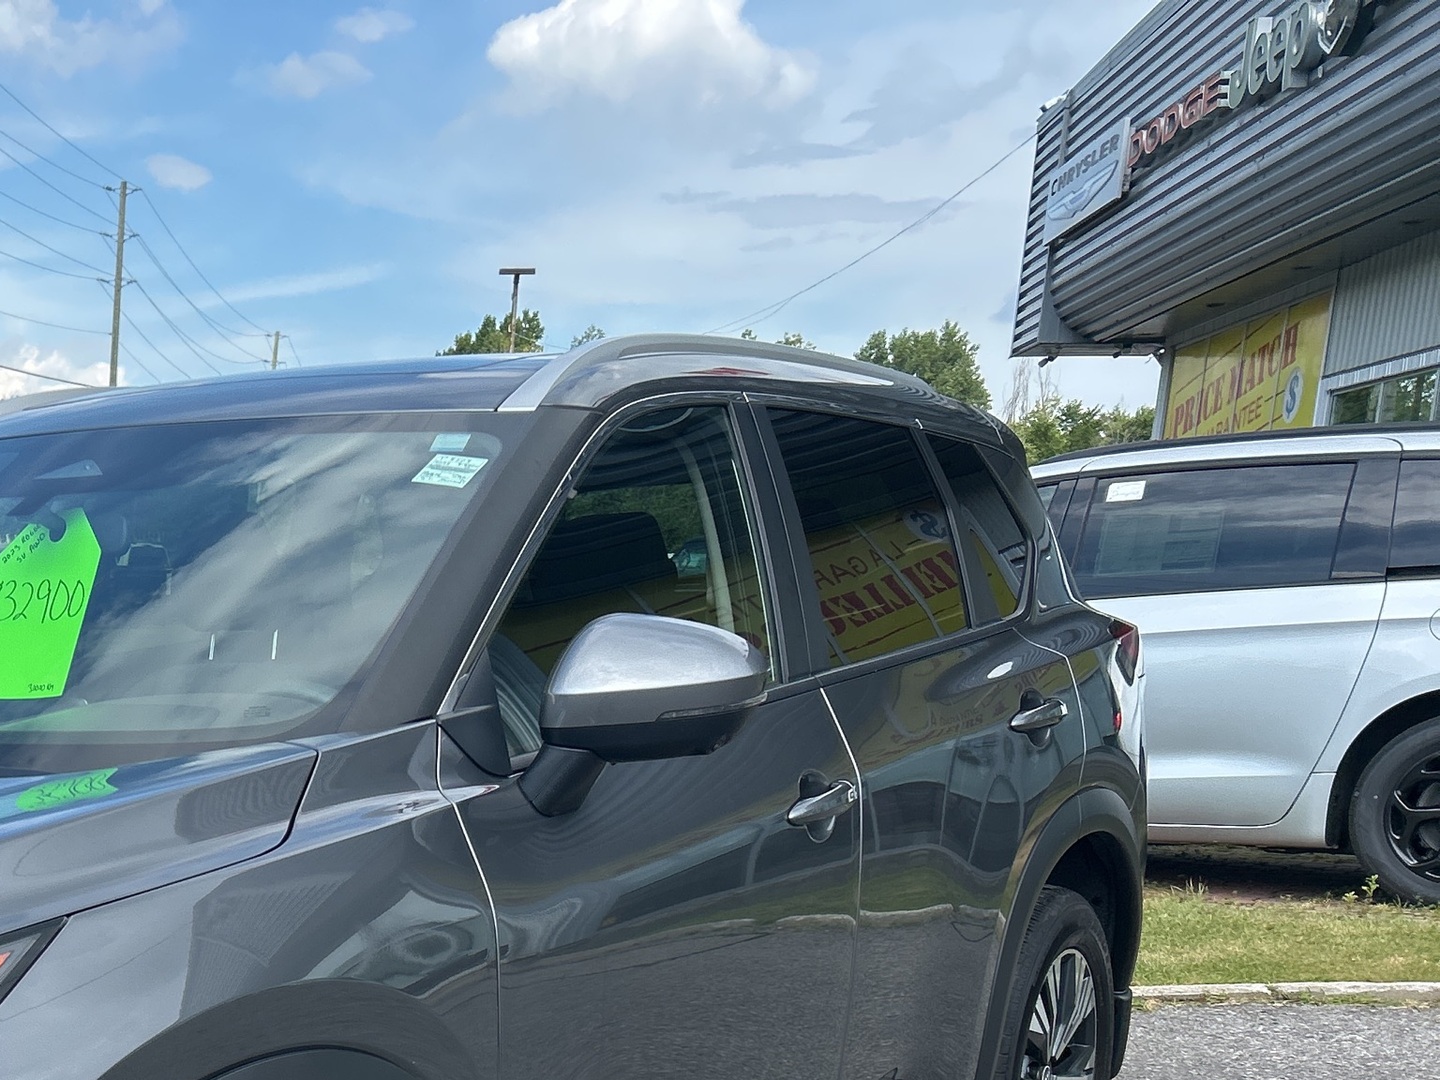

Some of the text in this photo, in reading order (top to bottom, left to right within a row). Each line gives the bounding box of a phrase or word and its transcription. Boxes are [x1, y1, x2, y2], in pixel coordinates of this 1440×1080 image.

[1227, 1, 1311, 109] Jeep
[1051, 133, 1121, 197] CHRYSLER
[1127, 69, 1227, 168] DODGE
[1172, 321, 1301, 439] PRICE MATCH
